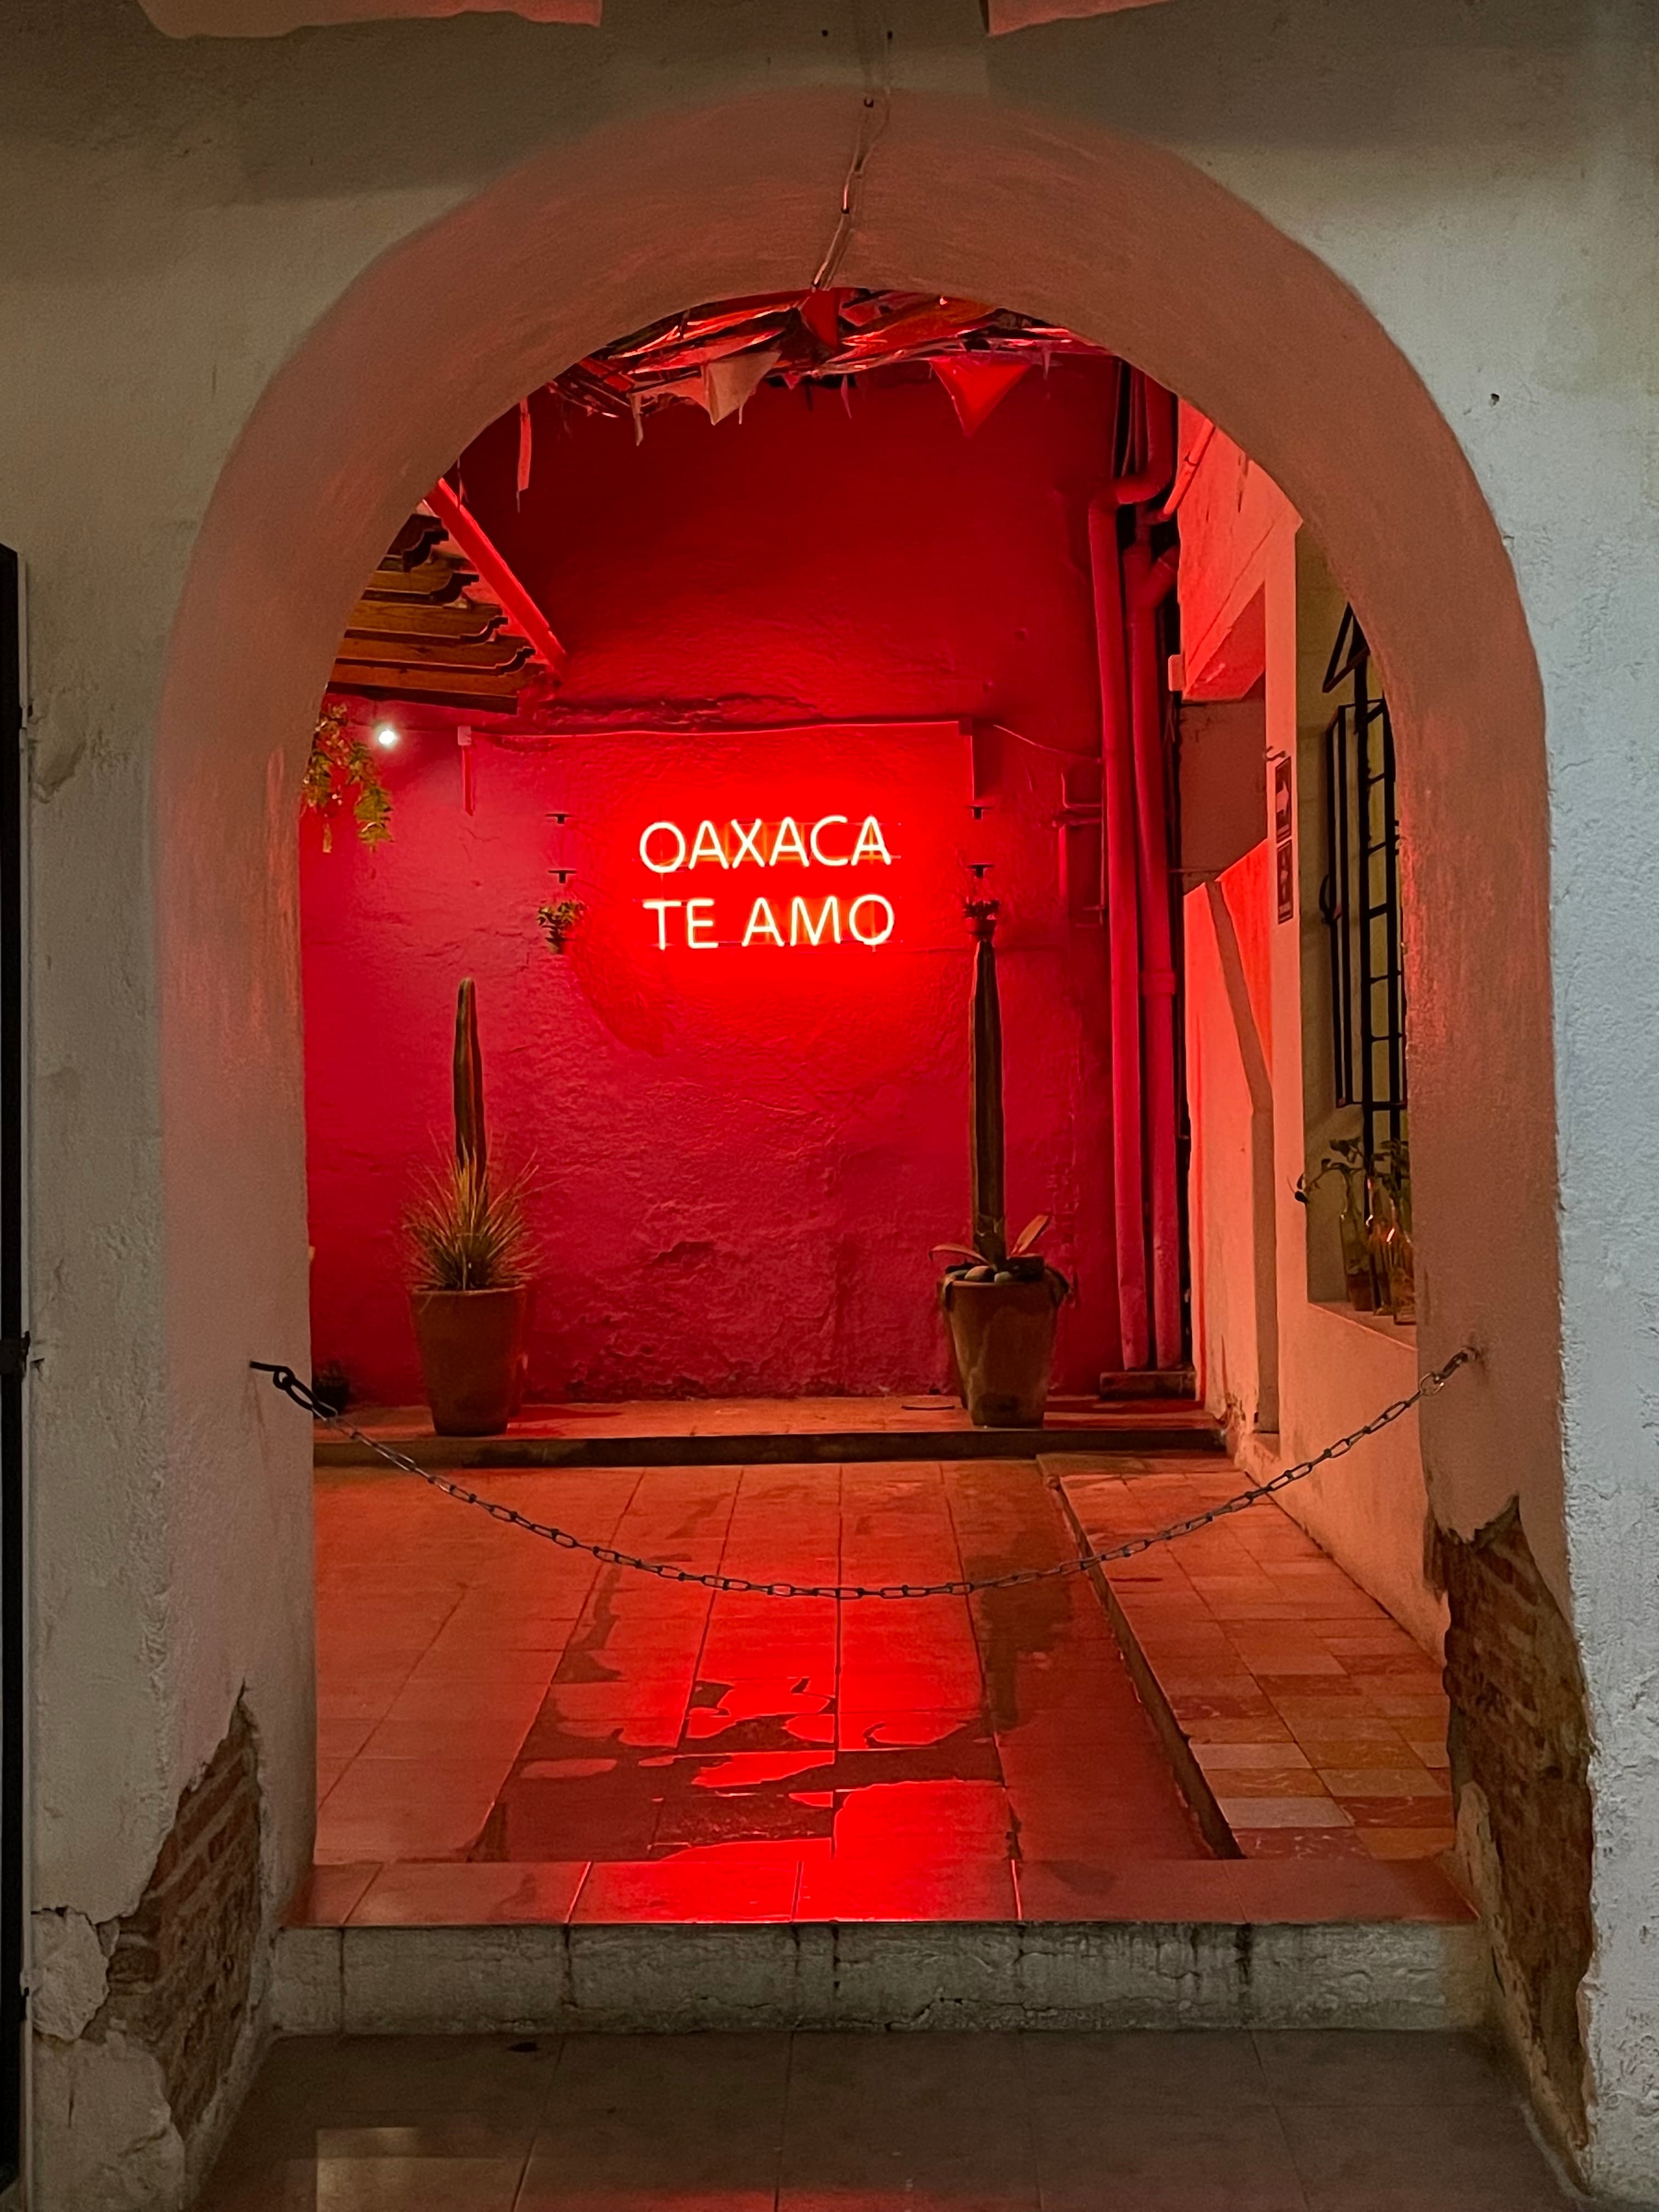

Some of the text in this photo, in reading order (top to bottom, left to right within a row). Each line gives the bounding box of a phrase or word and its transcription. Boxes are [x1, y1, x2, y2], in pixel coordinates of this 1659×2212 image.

[640, 815, 891, 873] OAXACA
[642, 894, 895, 950] TE AMO
